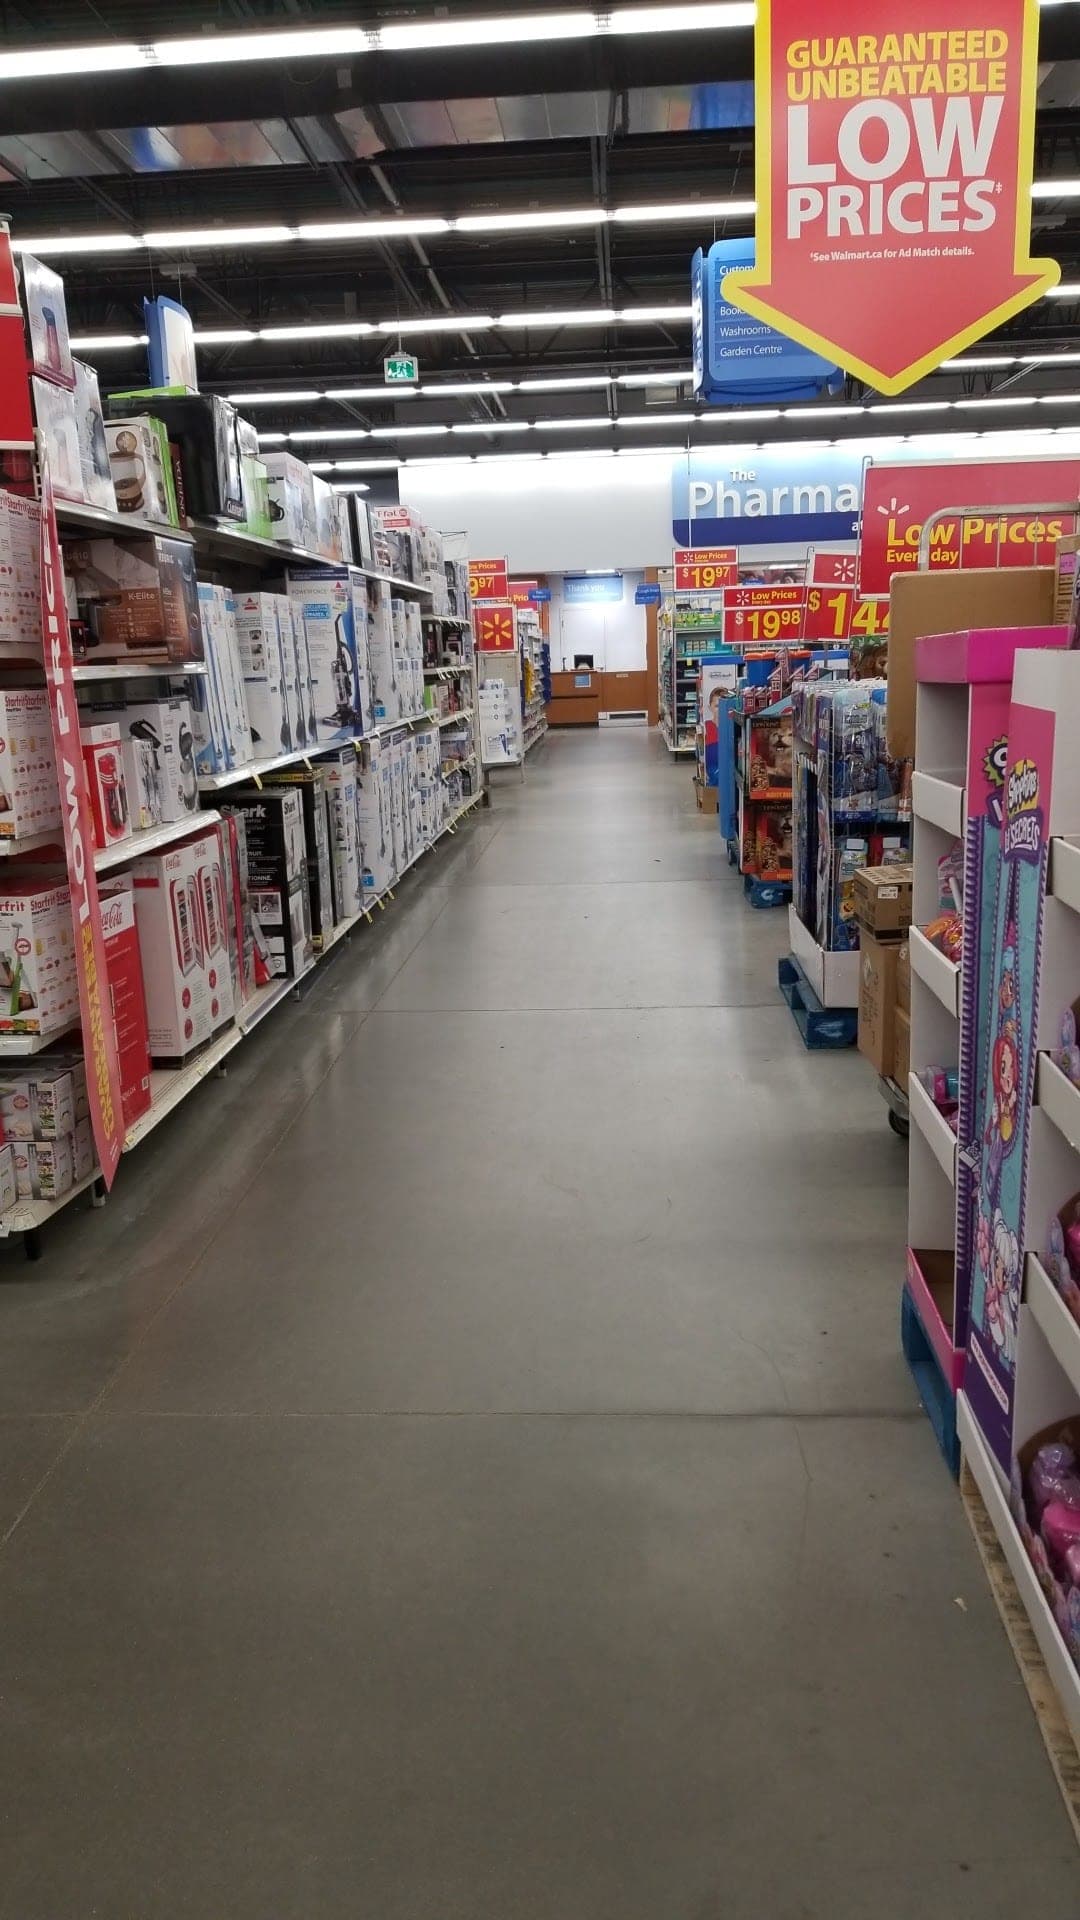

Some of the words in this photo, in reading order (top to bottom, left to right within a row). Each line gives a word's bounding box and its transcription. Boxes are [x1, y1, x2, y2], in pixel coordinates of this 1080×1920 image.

[786, 29, 1009, 69] GUARANTEED
[787, 62, 1006, 102] UNBEATABLE
[787, 95, 1004, 185] LOW
[830, 249, 883, 262] Walmart.ca
[883, 248, 897, 259] for
[898, 247, 912, 258] Ad
[912, 246, 941, 258] Match
[941, 245, 975, 256] details.
[720, 326, 771, 337] Washrooms
[720, 346, 752, 358] Garden
[753, 344, 783, 355] Centre
[730, 468, 757, 481] The
[689, 480, 860, 520] Pharma
[887, 518, 956, 546] Low
[963, 514, 1063, 545] Prices
[682, 567, 689, 578] $
[127, 591, 156, 601] K-Elite
[751, 592, 770, 600] Low
[771, 590, 797, 599] Prices
[808, 590, 821, 613] $
[735, 611, 743, 625] $
[220, 804, 267, 818] Shark
[62, 759, 91, 926] LOW
[31, 895, 56, 911] Starfrit
